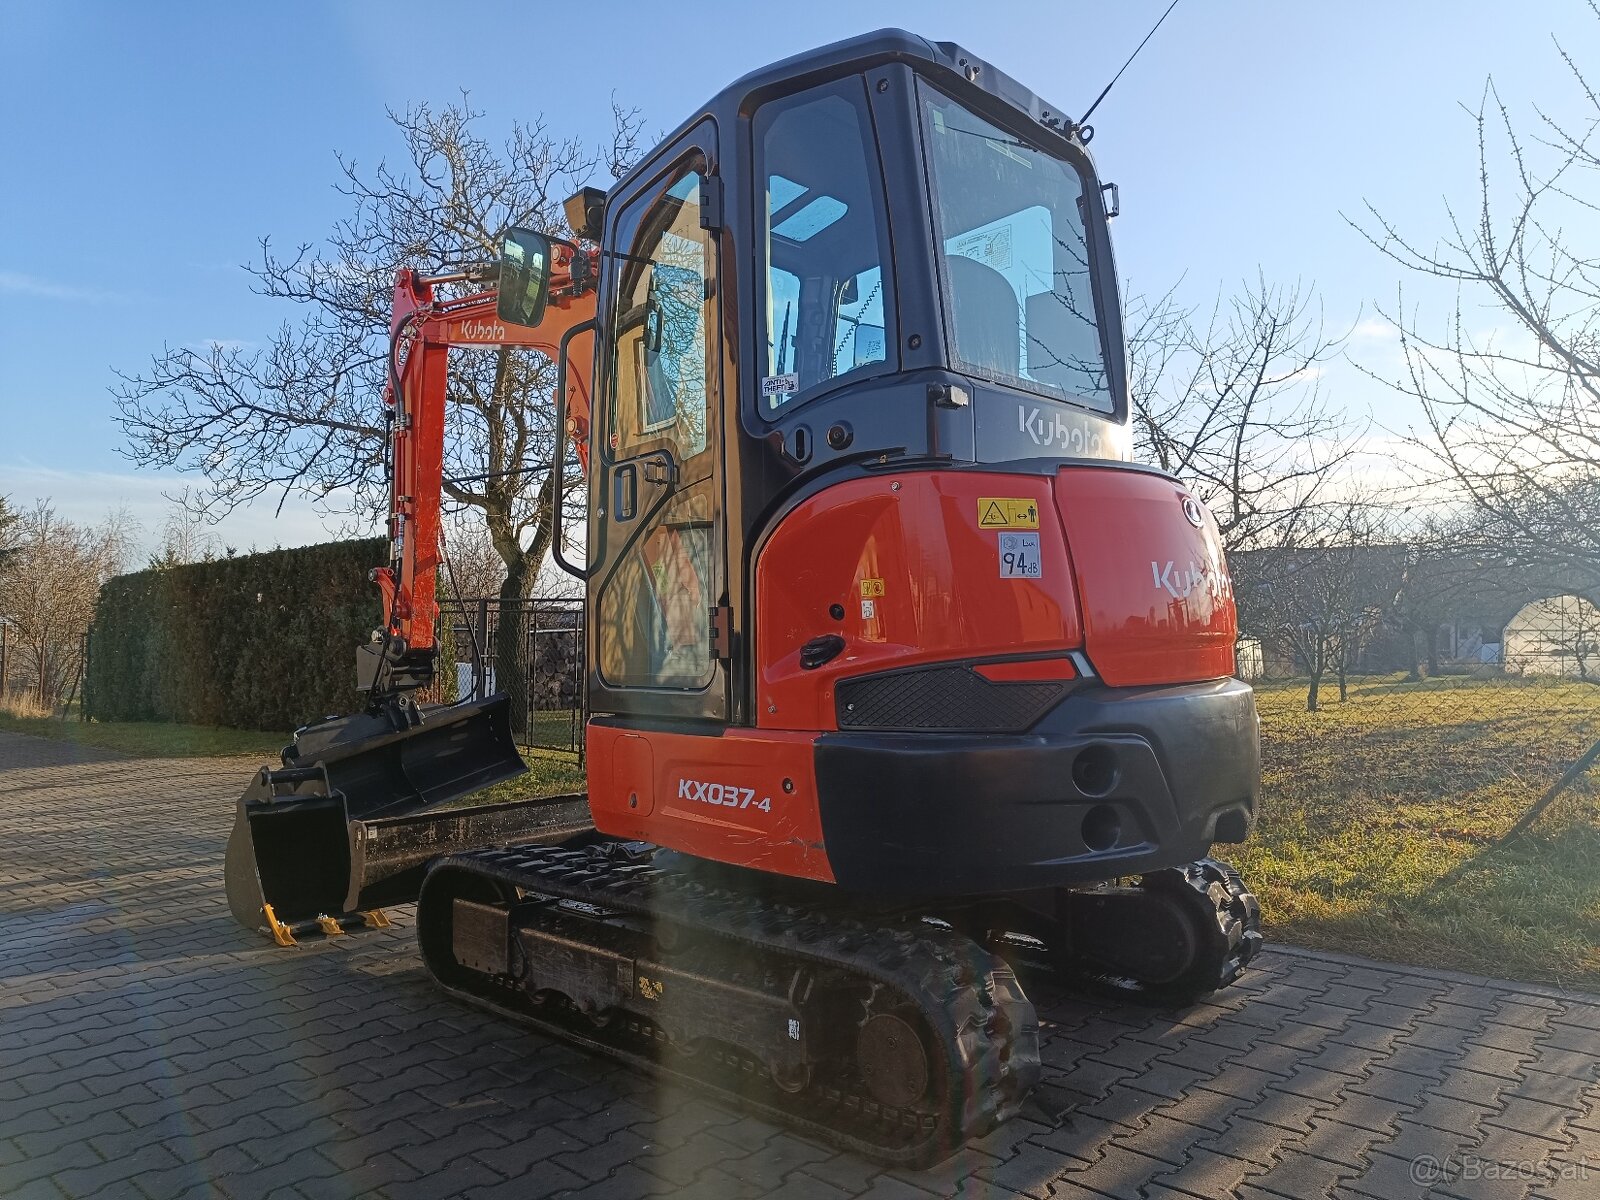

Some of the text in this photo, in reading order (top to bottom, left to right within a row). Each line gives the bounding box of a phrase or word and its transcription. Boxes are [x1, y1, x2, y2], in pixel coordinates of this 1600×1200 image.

[461, 320, 505, 340] Kubota
[764, 384, 785, 392] THEFT
[1019, 405, 1103, 457] Kubota
[678, 779, 771, 812] KX037-4
